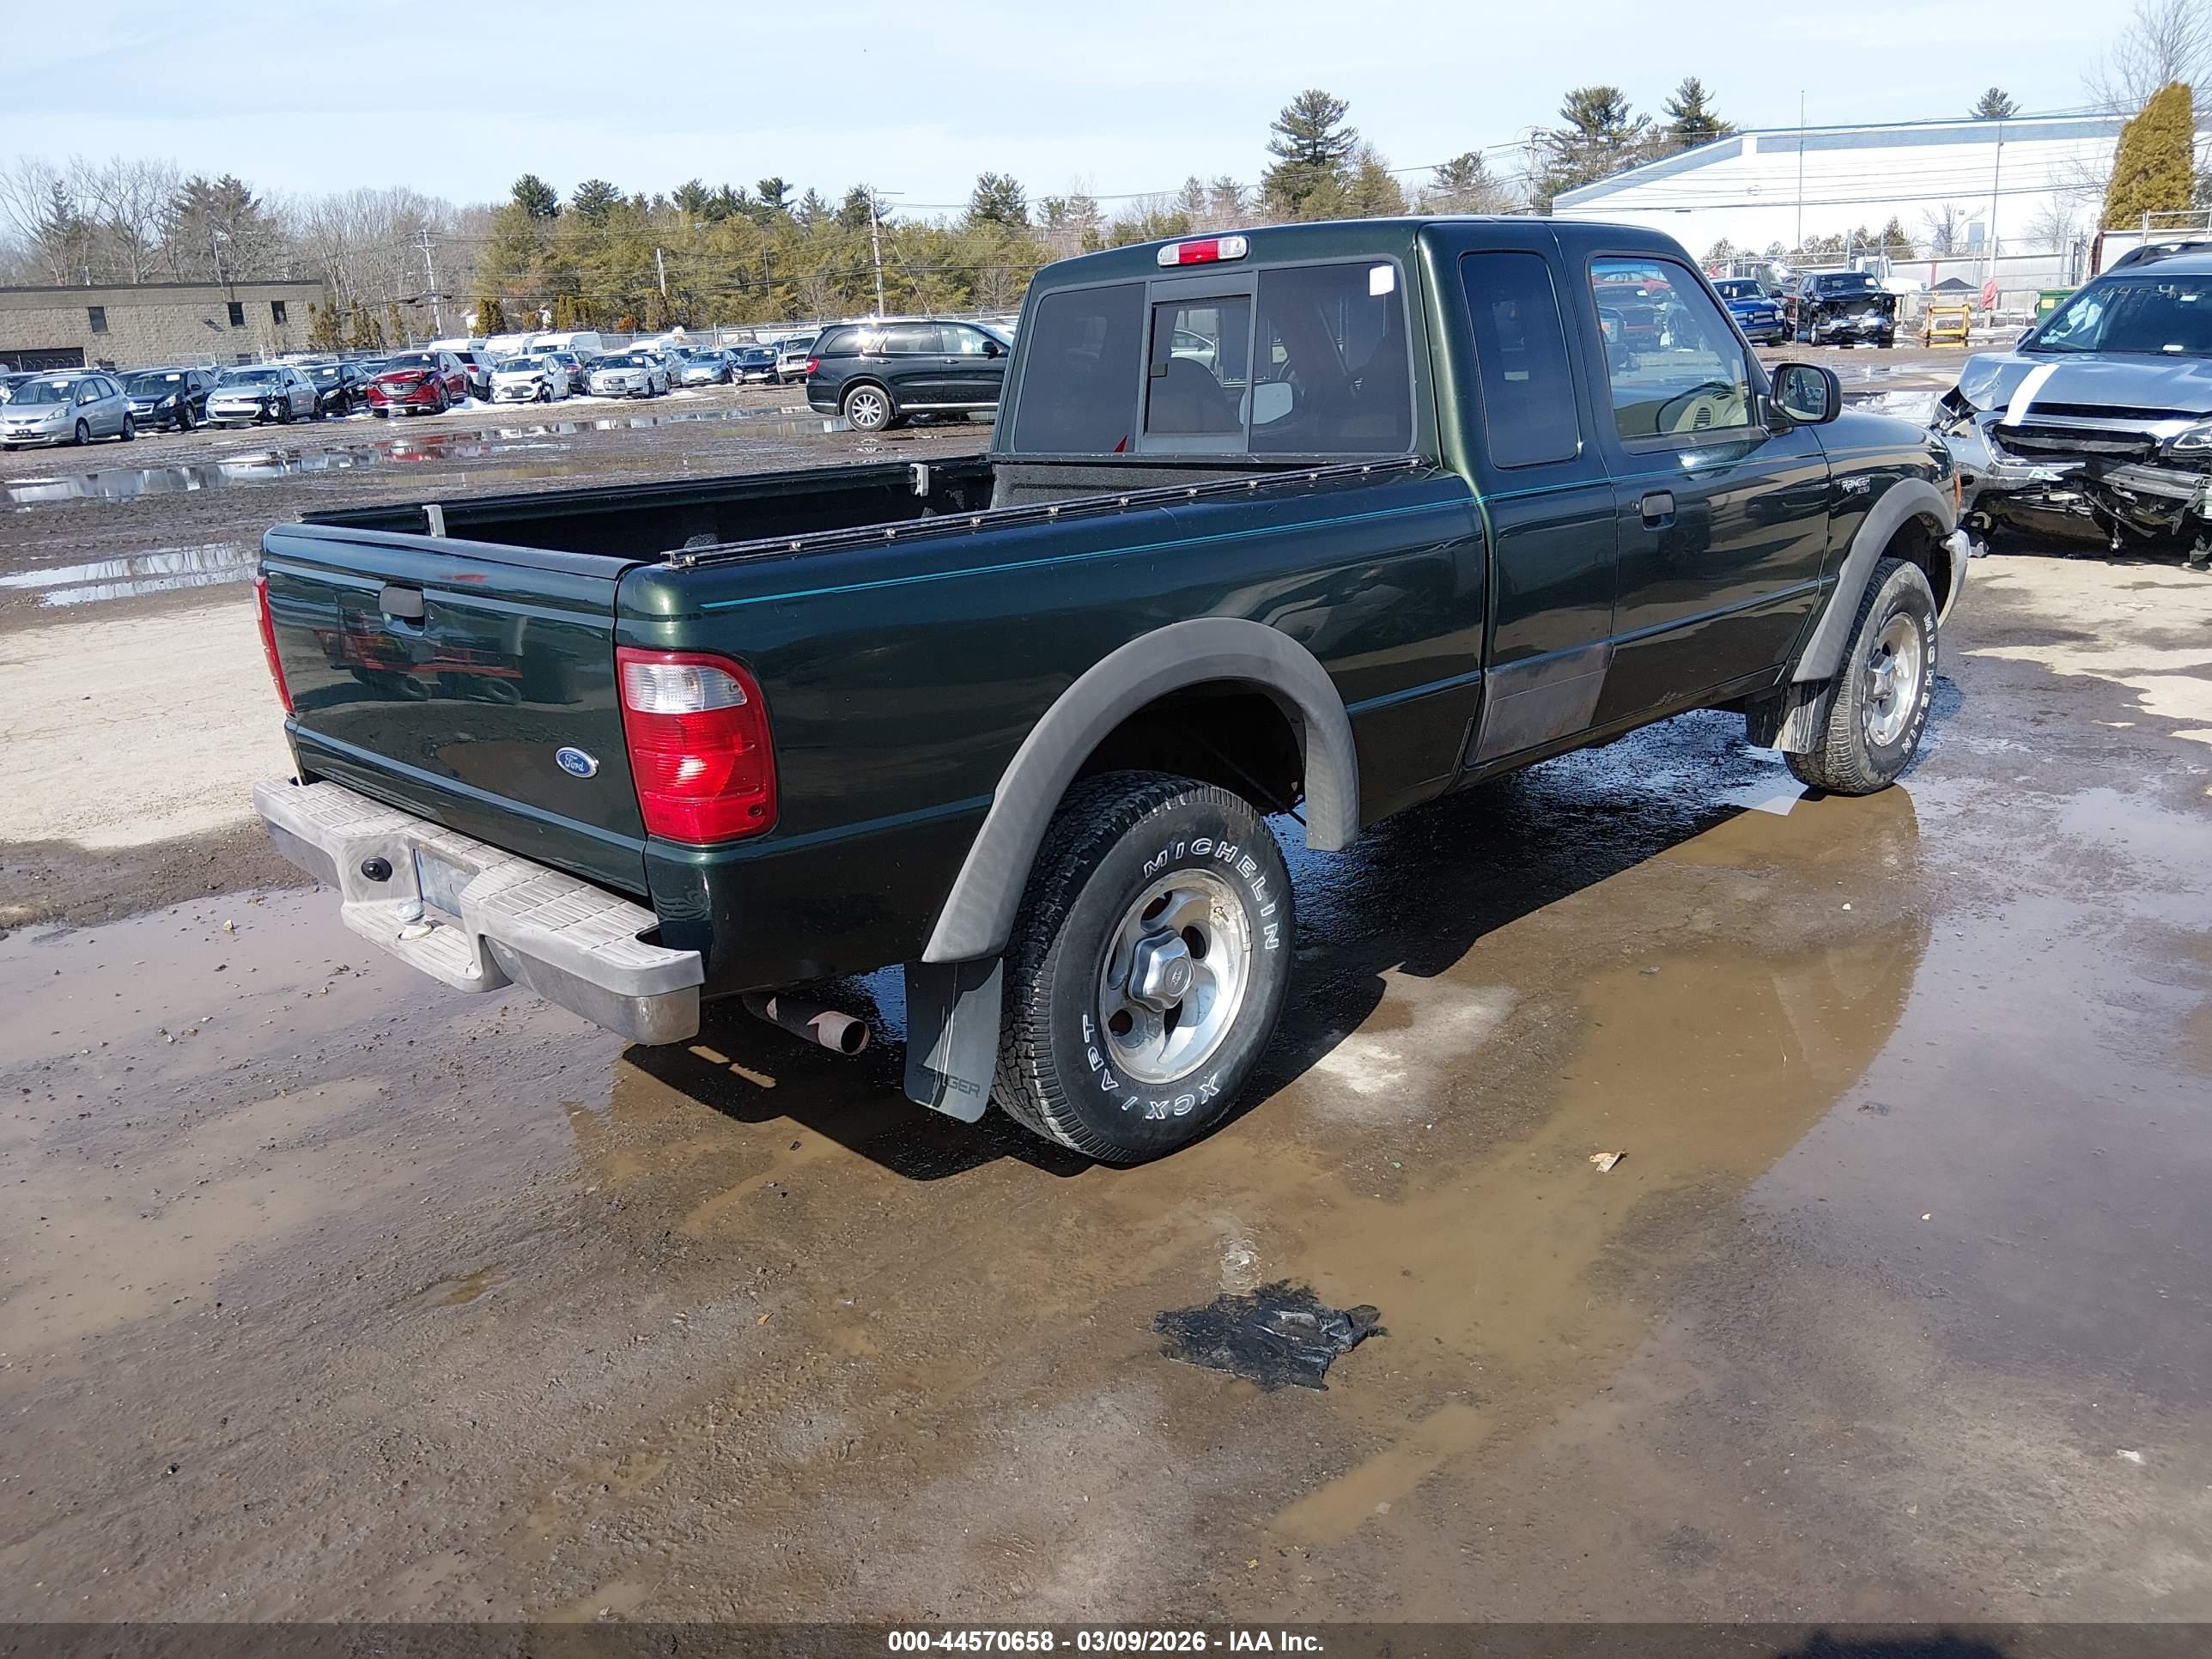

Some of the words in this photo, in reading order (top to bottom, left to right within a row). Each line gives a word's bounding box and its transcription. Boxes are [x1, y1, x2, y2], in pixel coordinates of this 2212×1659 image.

[1901, 611, 1937, 754] MICHELIN
[564, 753, 585, 772] Ford
[1143, 837, 1279, 950] MICHELIN
